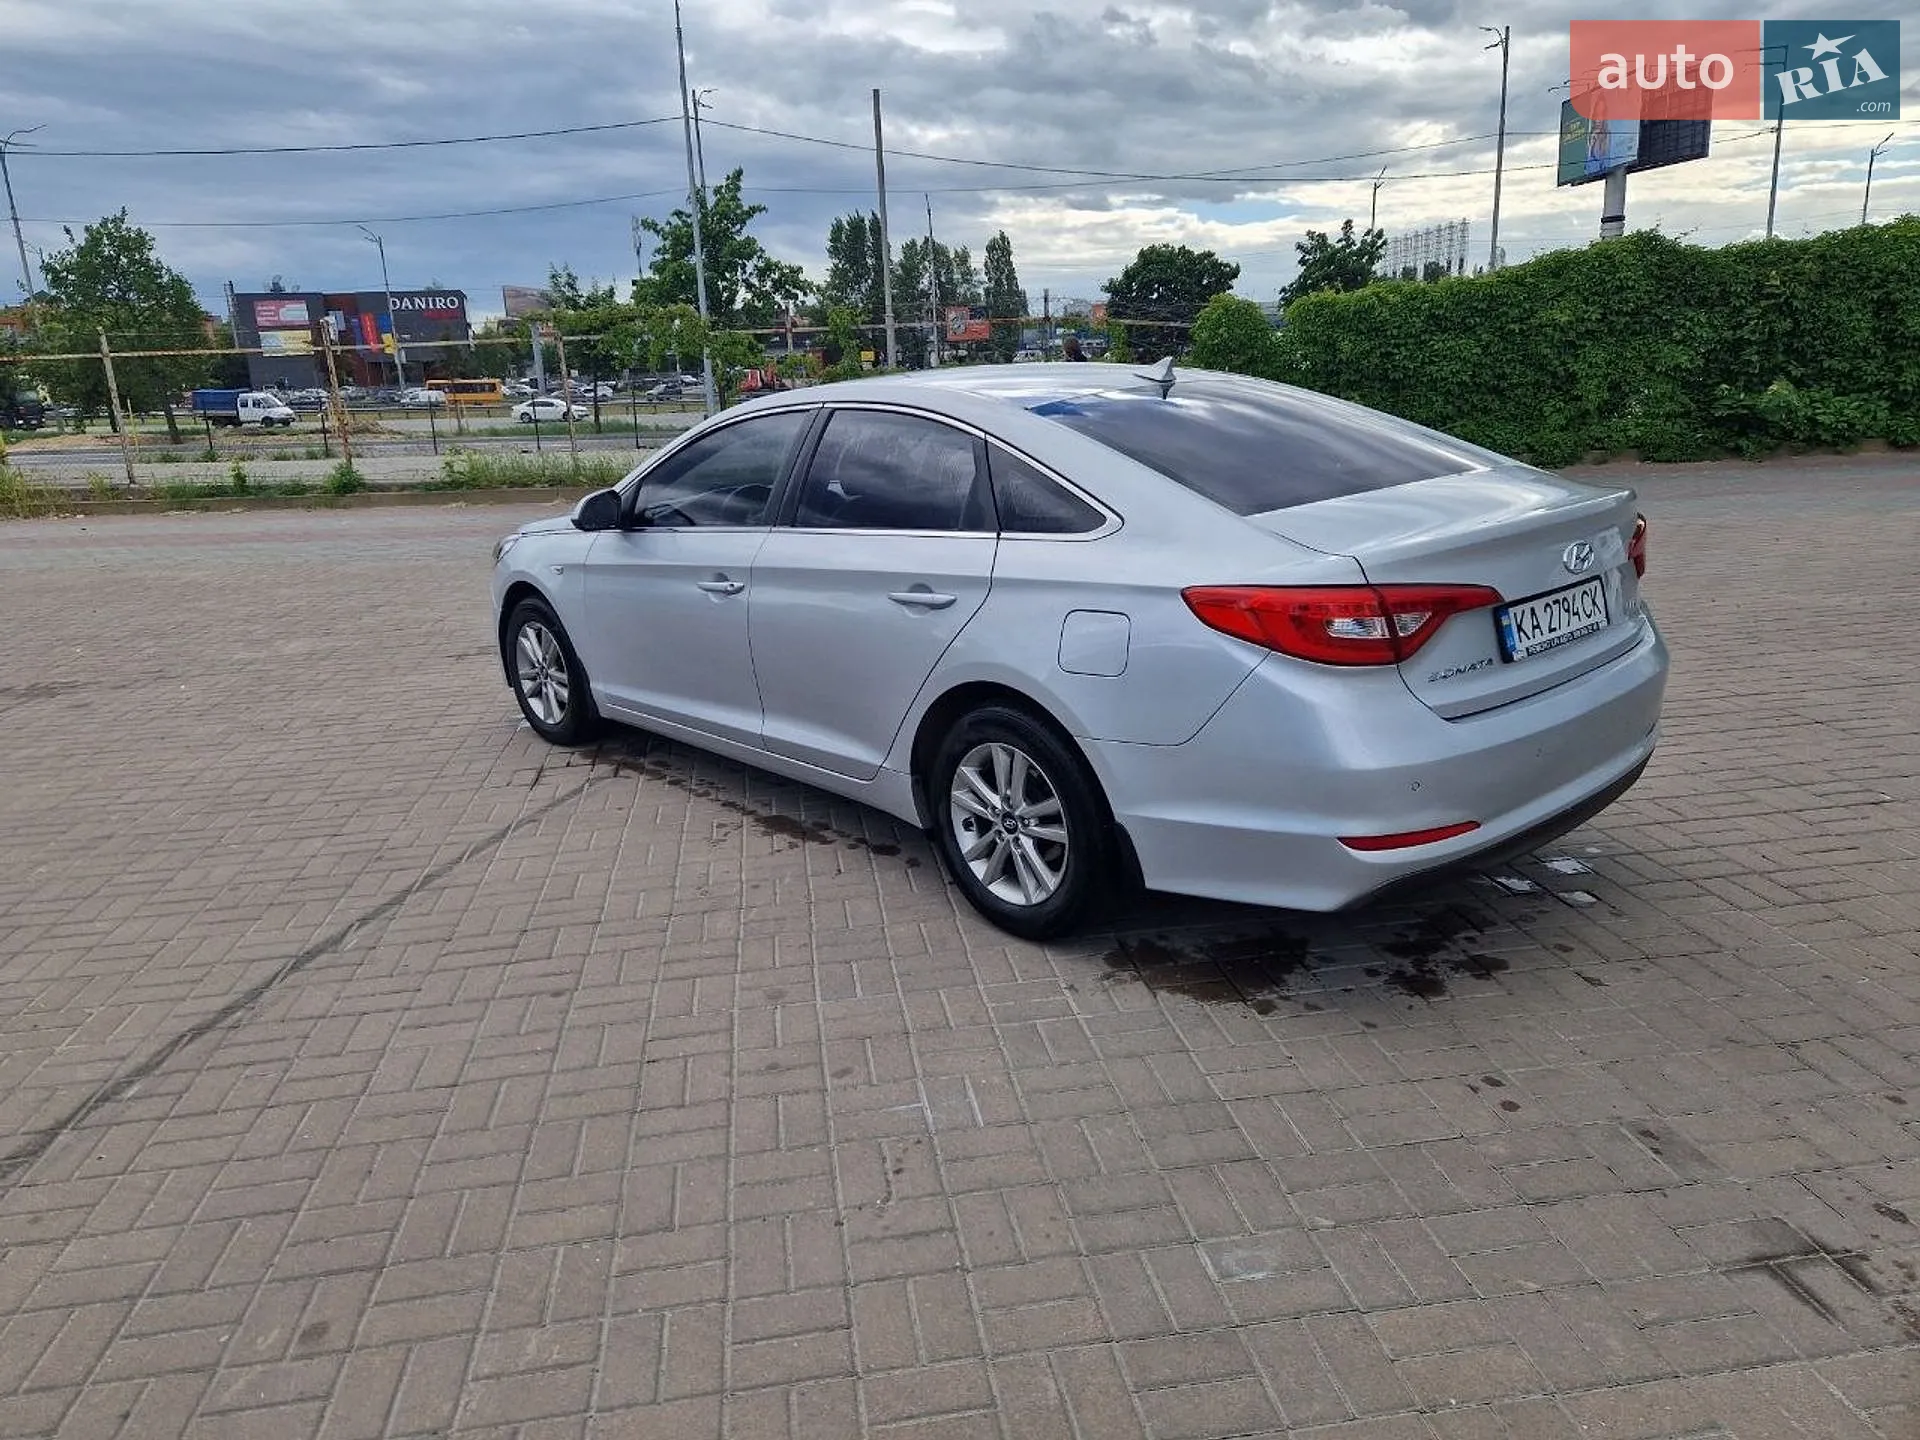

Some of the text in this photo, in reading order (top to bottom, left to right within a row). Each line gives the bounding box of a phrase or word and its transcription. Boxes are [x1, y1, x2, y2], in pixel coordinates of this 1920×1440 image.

[389, 296, 458, 310] DANIRO
[1513, 606, 1544, 643] KA
[1543, 593, 1581, 633] 2794
